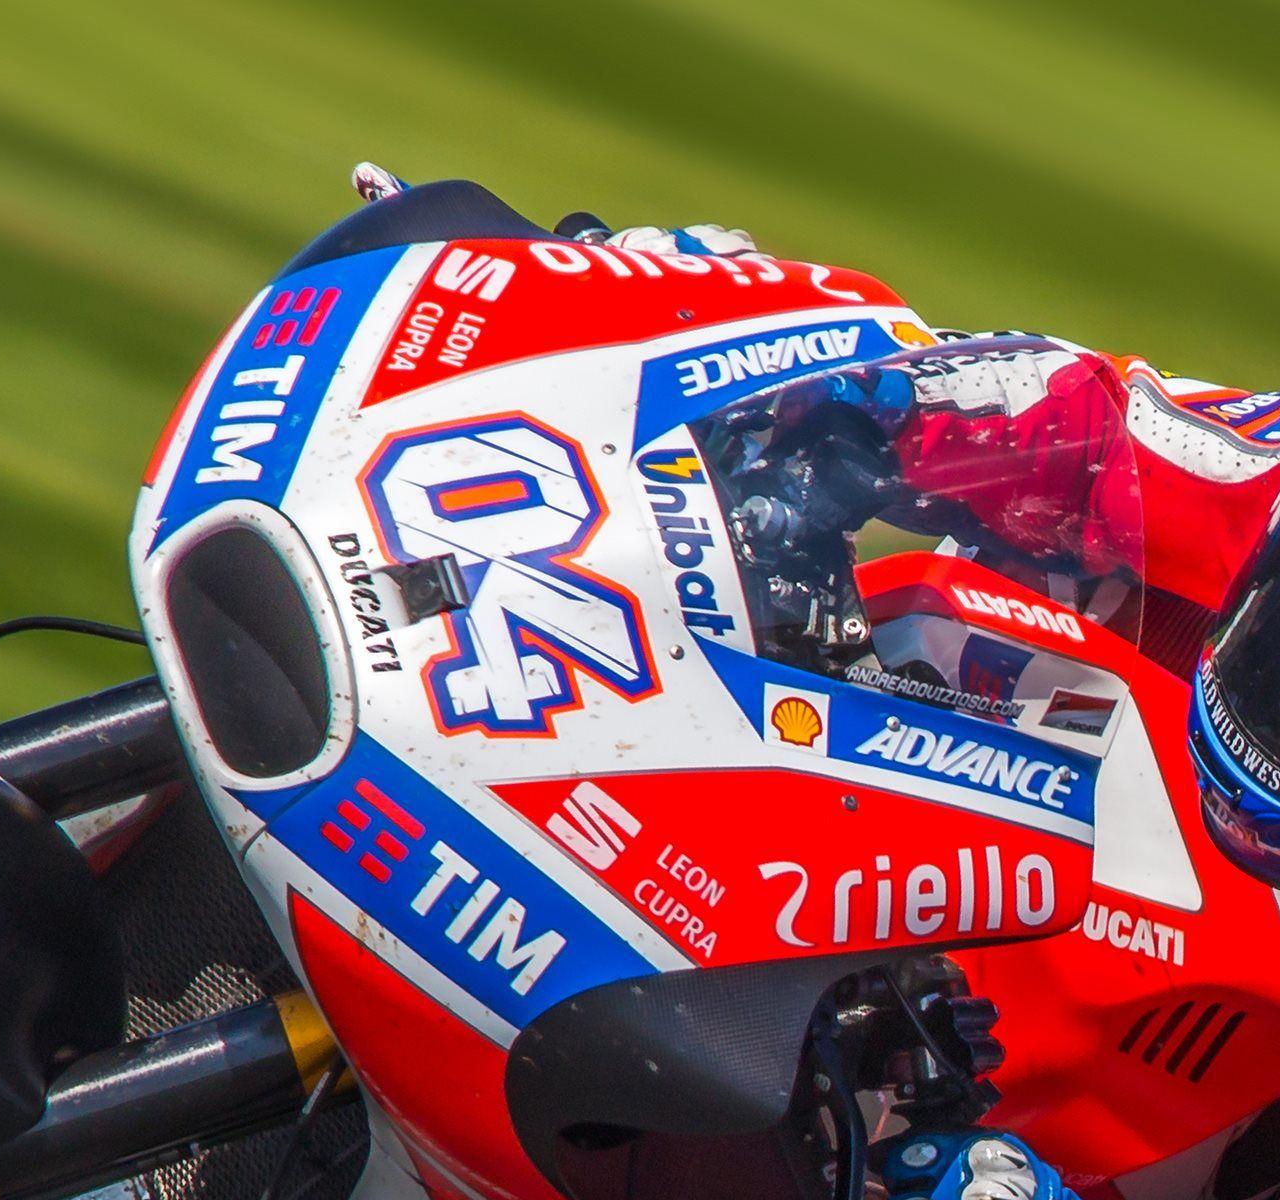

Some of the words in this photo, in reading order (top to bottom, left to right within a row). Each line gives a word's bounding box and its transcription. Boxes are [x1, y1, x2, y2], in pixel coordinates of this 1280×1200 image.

[386, 301, 443, 371] CUPRA
[438, 312, 486, 367] LEON
[674, 325, 862, 397] ADVANCE
[195, 354, 306, 483] TIM
[357, 410, 663, 738] 04
[636, 448, 735, 638] Unibat
[327, 533, 403, 673] DUCATI
[950, 585, 1086, 641] DUCATI
[855, 725, 1080, 810] ADVANCE
[1210, 702, 1244, 755] WILD
[655, 843, 726, 907] LEON
[833, 845, 1055, 944] riello
[409, 840, 567, 997] TIM
[632, 878, 718, 958] CUPRA
[1070, 901, 1184, 967] UCATI
